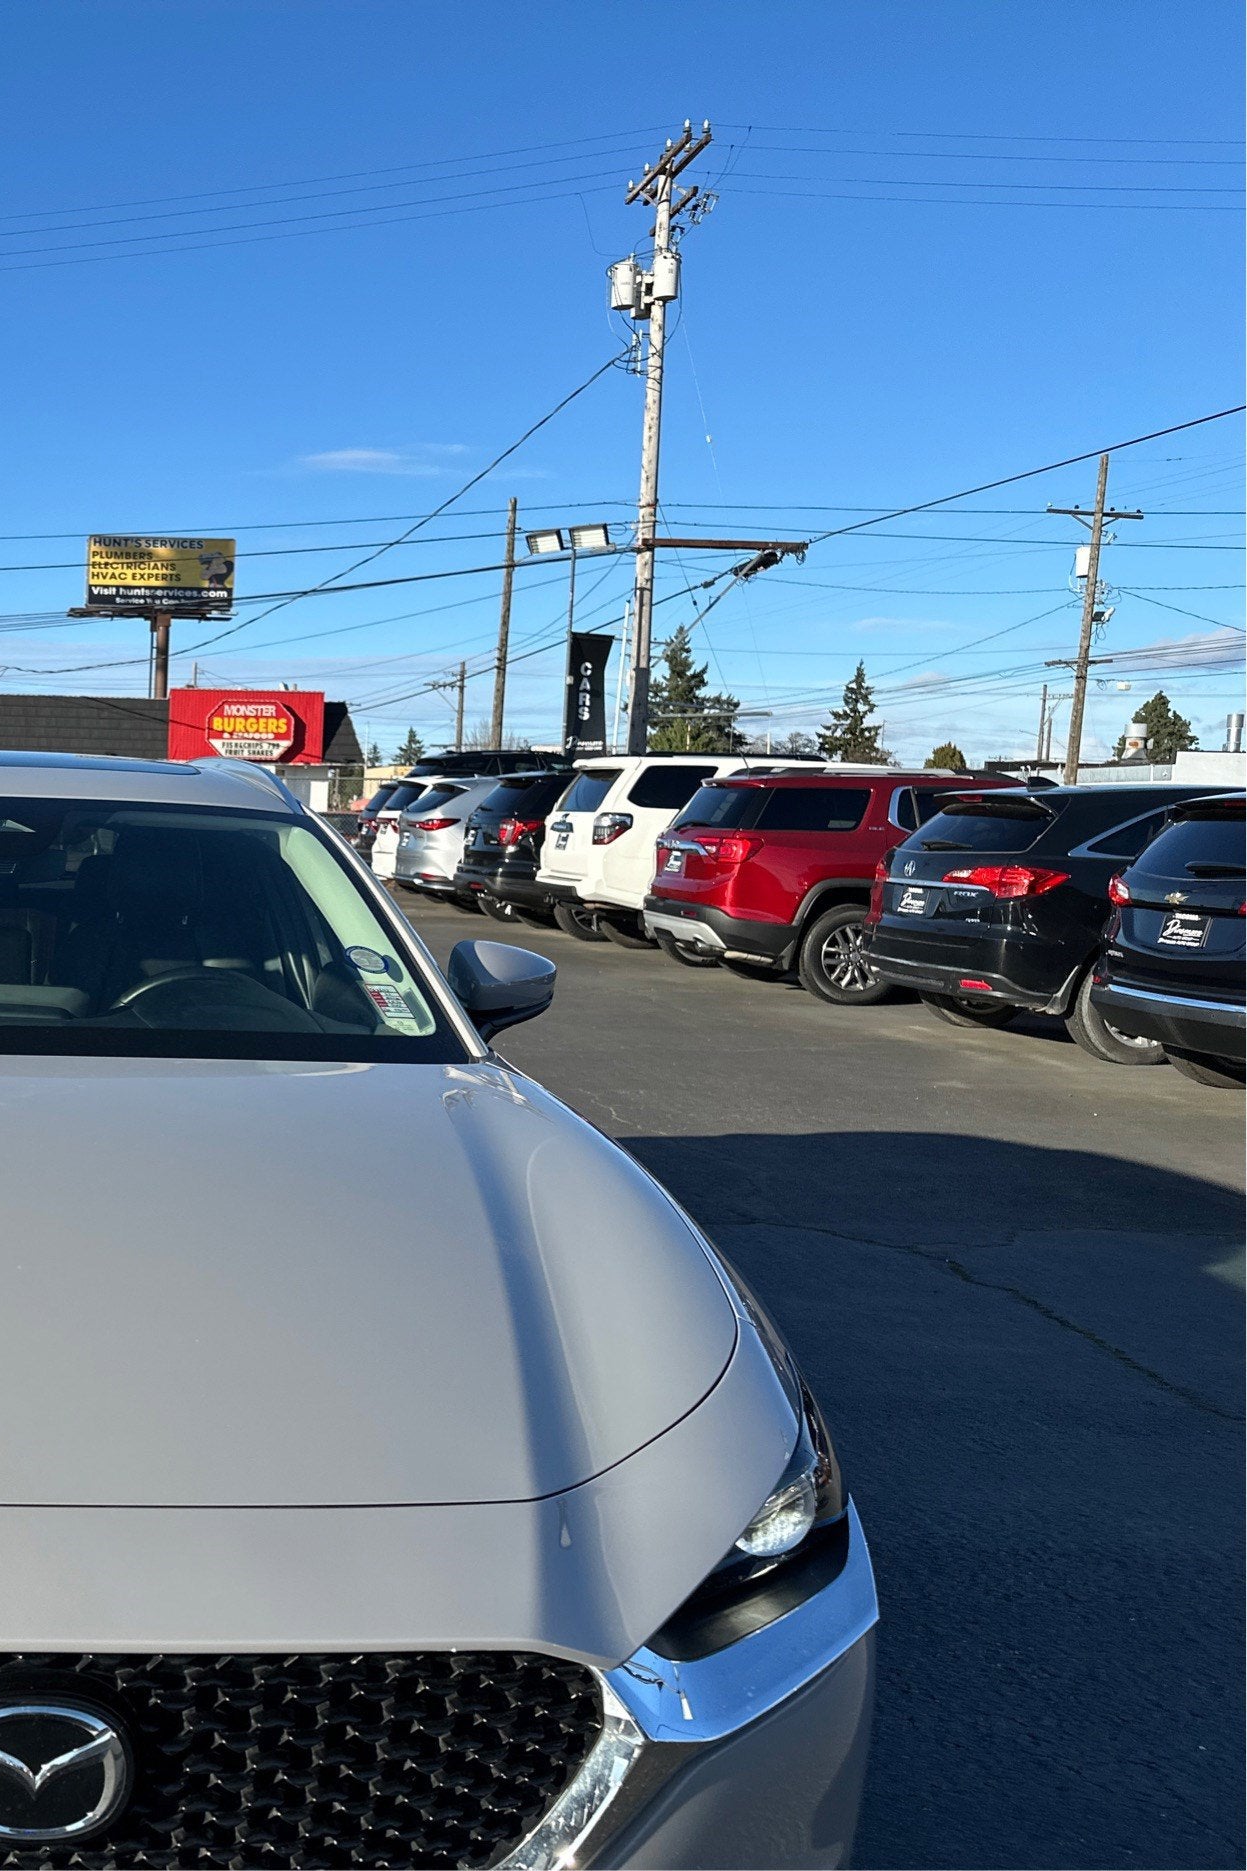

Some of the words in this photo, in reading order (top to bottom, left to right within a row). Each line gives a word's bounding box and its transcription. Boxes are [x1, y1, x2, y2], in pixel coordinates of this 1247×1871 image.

[93, 537, 142, 548] HUNT'S
[145, 539, 204, 549] SERVICES
[92, 550, 154, 560] PLUMBERS
[91, 561, 176, 572] ELECTRICIANS
[91, 571, 128, 581] HVAC
[132, 572, 182, 582] EXPERTS
[91, 586, 117, 596] Visit
[578, 661, 593, 721] CARS
[223, 704, 277, 717] MONSTER
[212, 716, 288, 734] BURGERS
